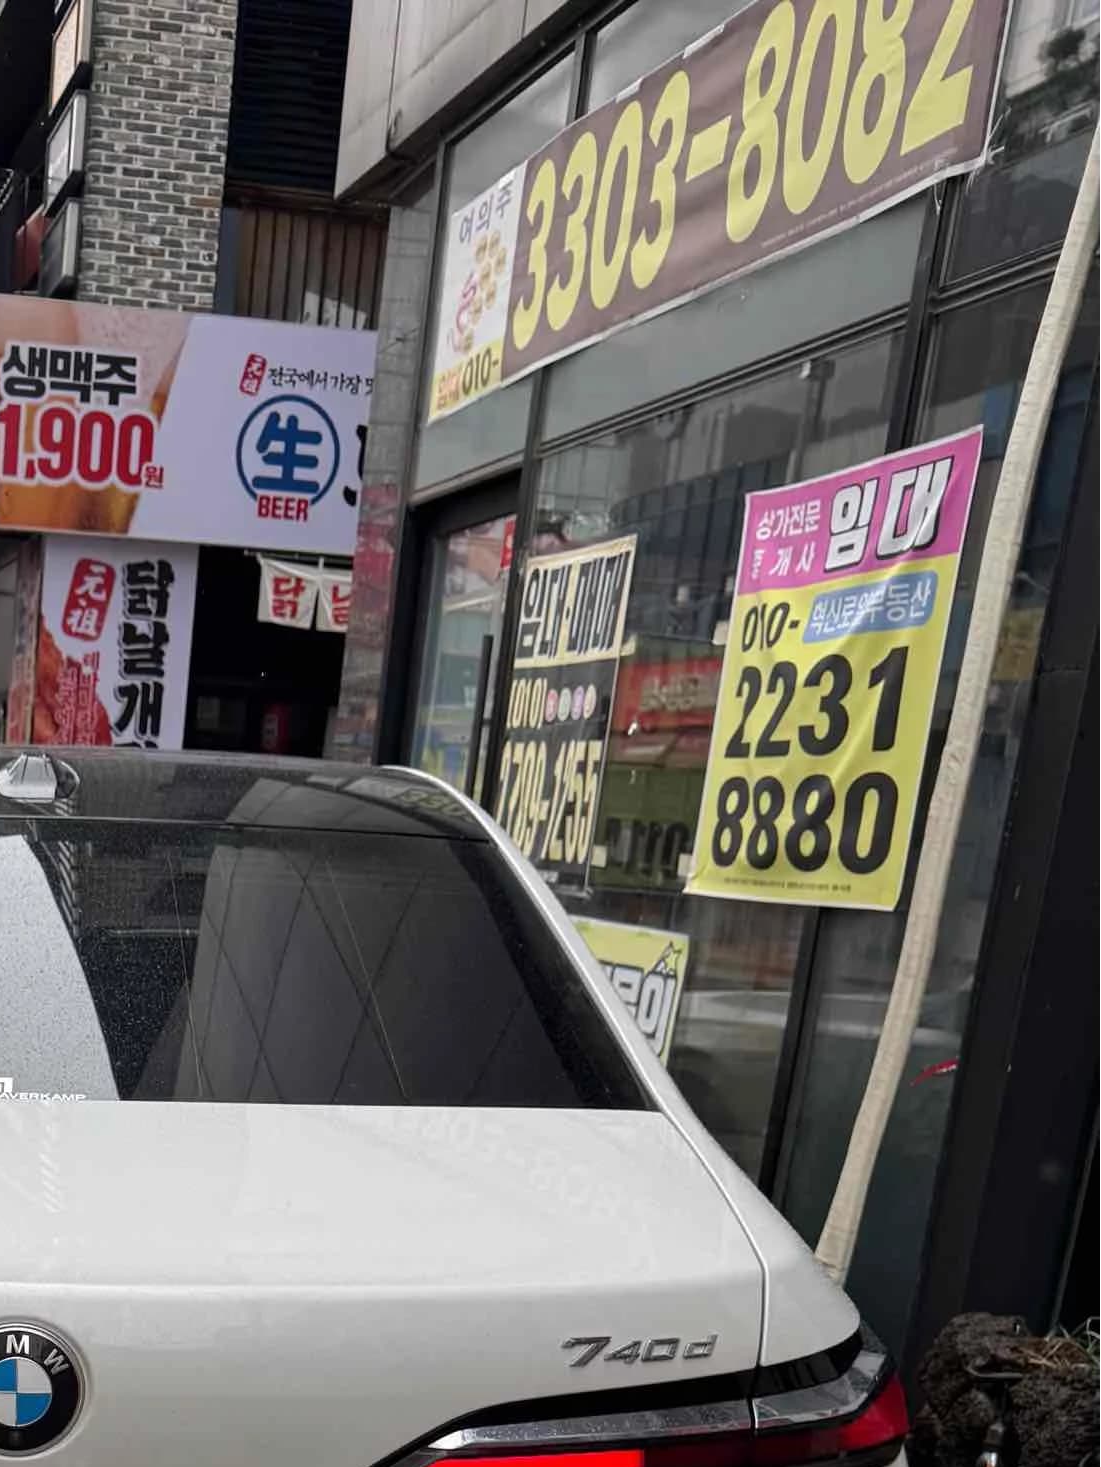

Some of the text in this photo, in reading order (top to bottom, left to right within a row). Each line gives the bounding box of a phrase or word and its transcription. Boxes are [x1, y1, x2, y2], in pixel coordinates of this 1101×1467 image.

[512, 0, 975, 350] 3303-8082
[459, 181, 513, 244] 여의주
[2, 344, 137, 406] 생맥주
[268, 364, 328, 390] 전국에서
[330, 370, 361, 396] 가장
[461, 347, 500, 396] 010-
[252, 411, 323, 494] 生
[257, 494, 309, 523] BEER
[756, 500, 821, 541] 상가전문
[820, 457, 954, 574] 임대
[66, 563, 108, 637] 元祖
[271, 575, 306, 619] 닭
[741, 602, 801, 652] 010-
[114, 559, 175, 748] 닭날개
[724, 646, 910, 759] 2231
[711, 771, 899, 875] 8880
[561, 1334, 719, 1368] 740d
